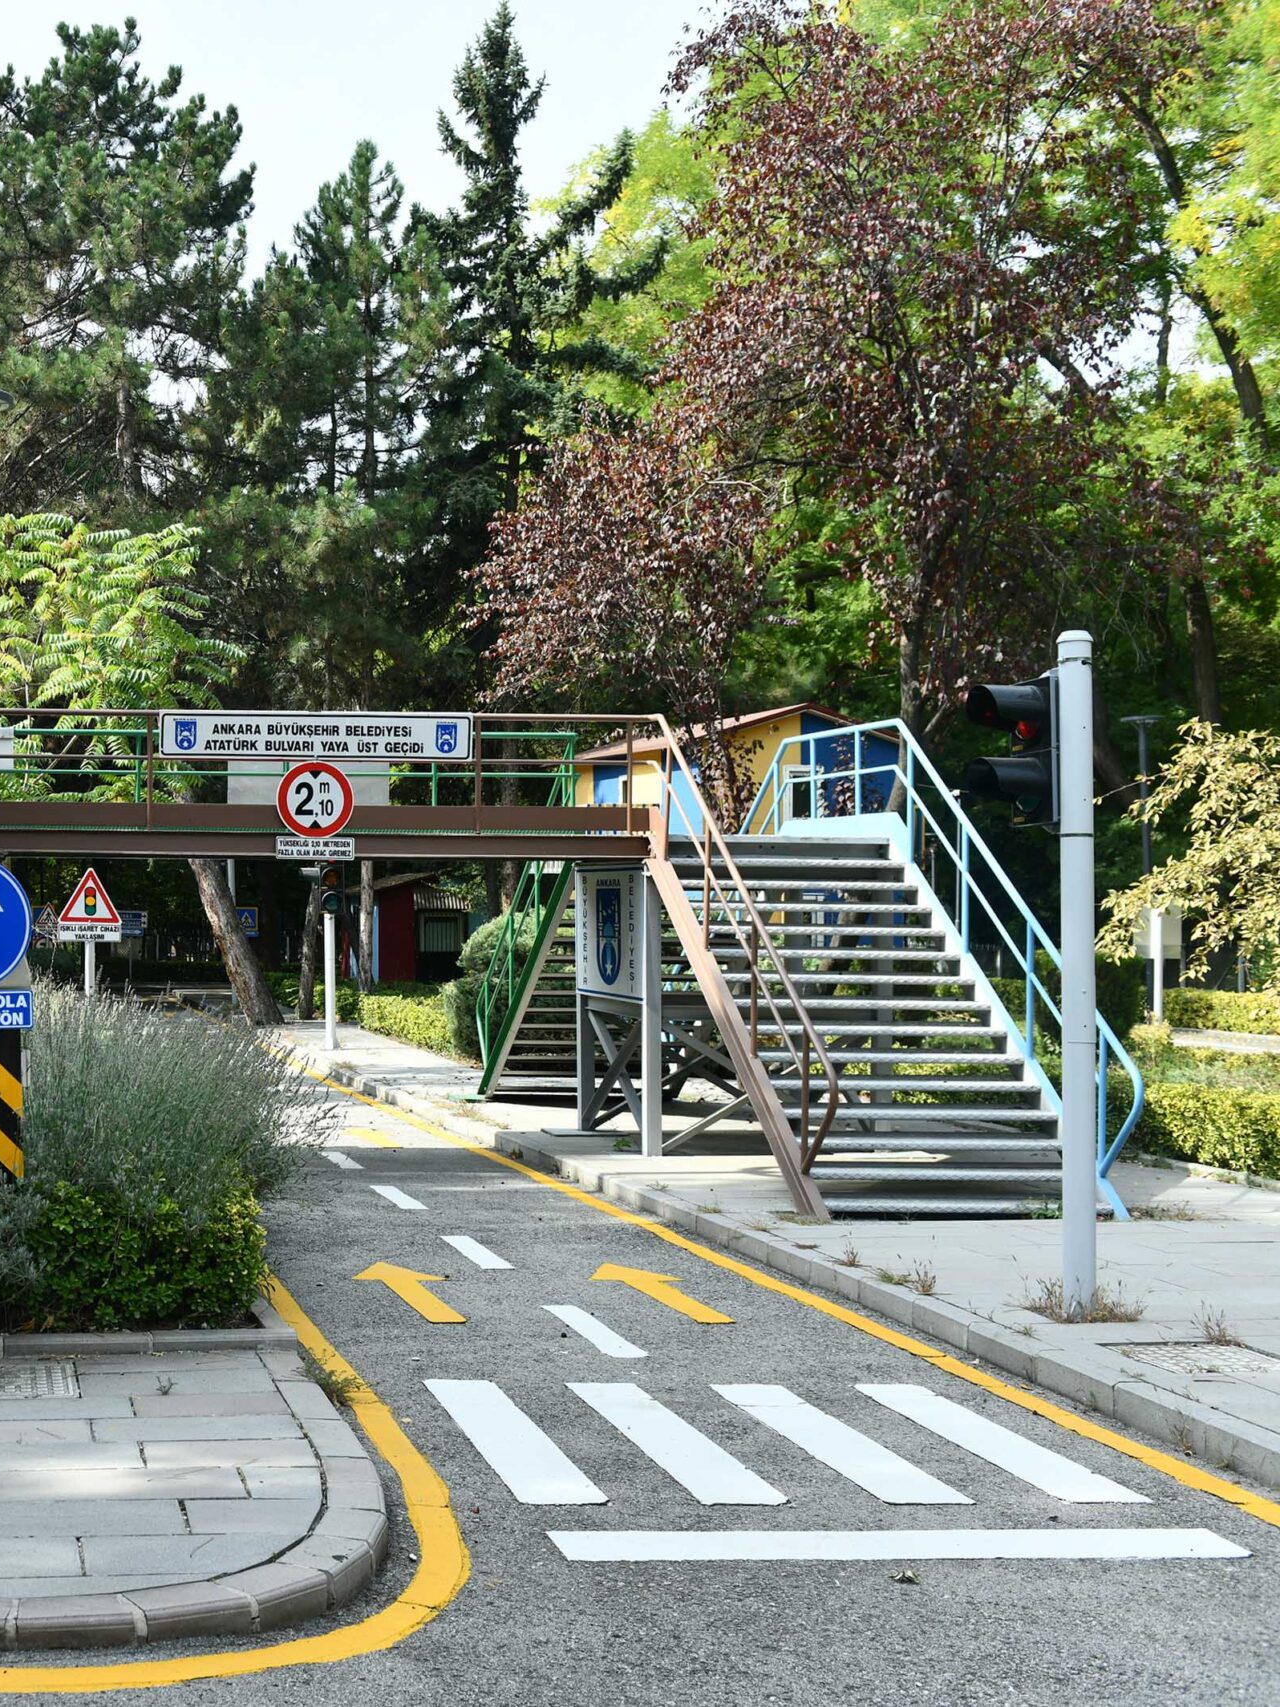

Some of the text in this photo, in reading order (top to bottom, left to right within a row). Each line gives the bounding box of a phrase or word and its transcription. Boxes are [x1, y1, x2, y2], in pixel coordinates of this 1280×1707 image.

[212, 723, 261, 735] ANKARA
[204, 737, 258, 751] ATATÜRK
[264, 740, 314, 752] BULVARI
[321, 741, 350, 753] YAYA
[357, 739, 379, 753] ÜST
[319, 781, 330, 793] m
[322, 840, 351, 848] METREDEN
[278, 848, 294, 856] FAZLA
[296, 849, 311, 857] OLAN
[596, 878, 621, 888] ANKARA
